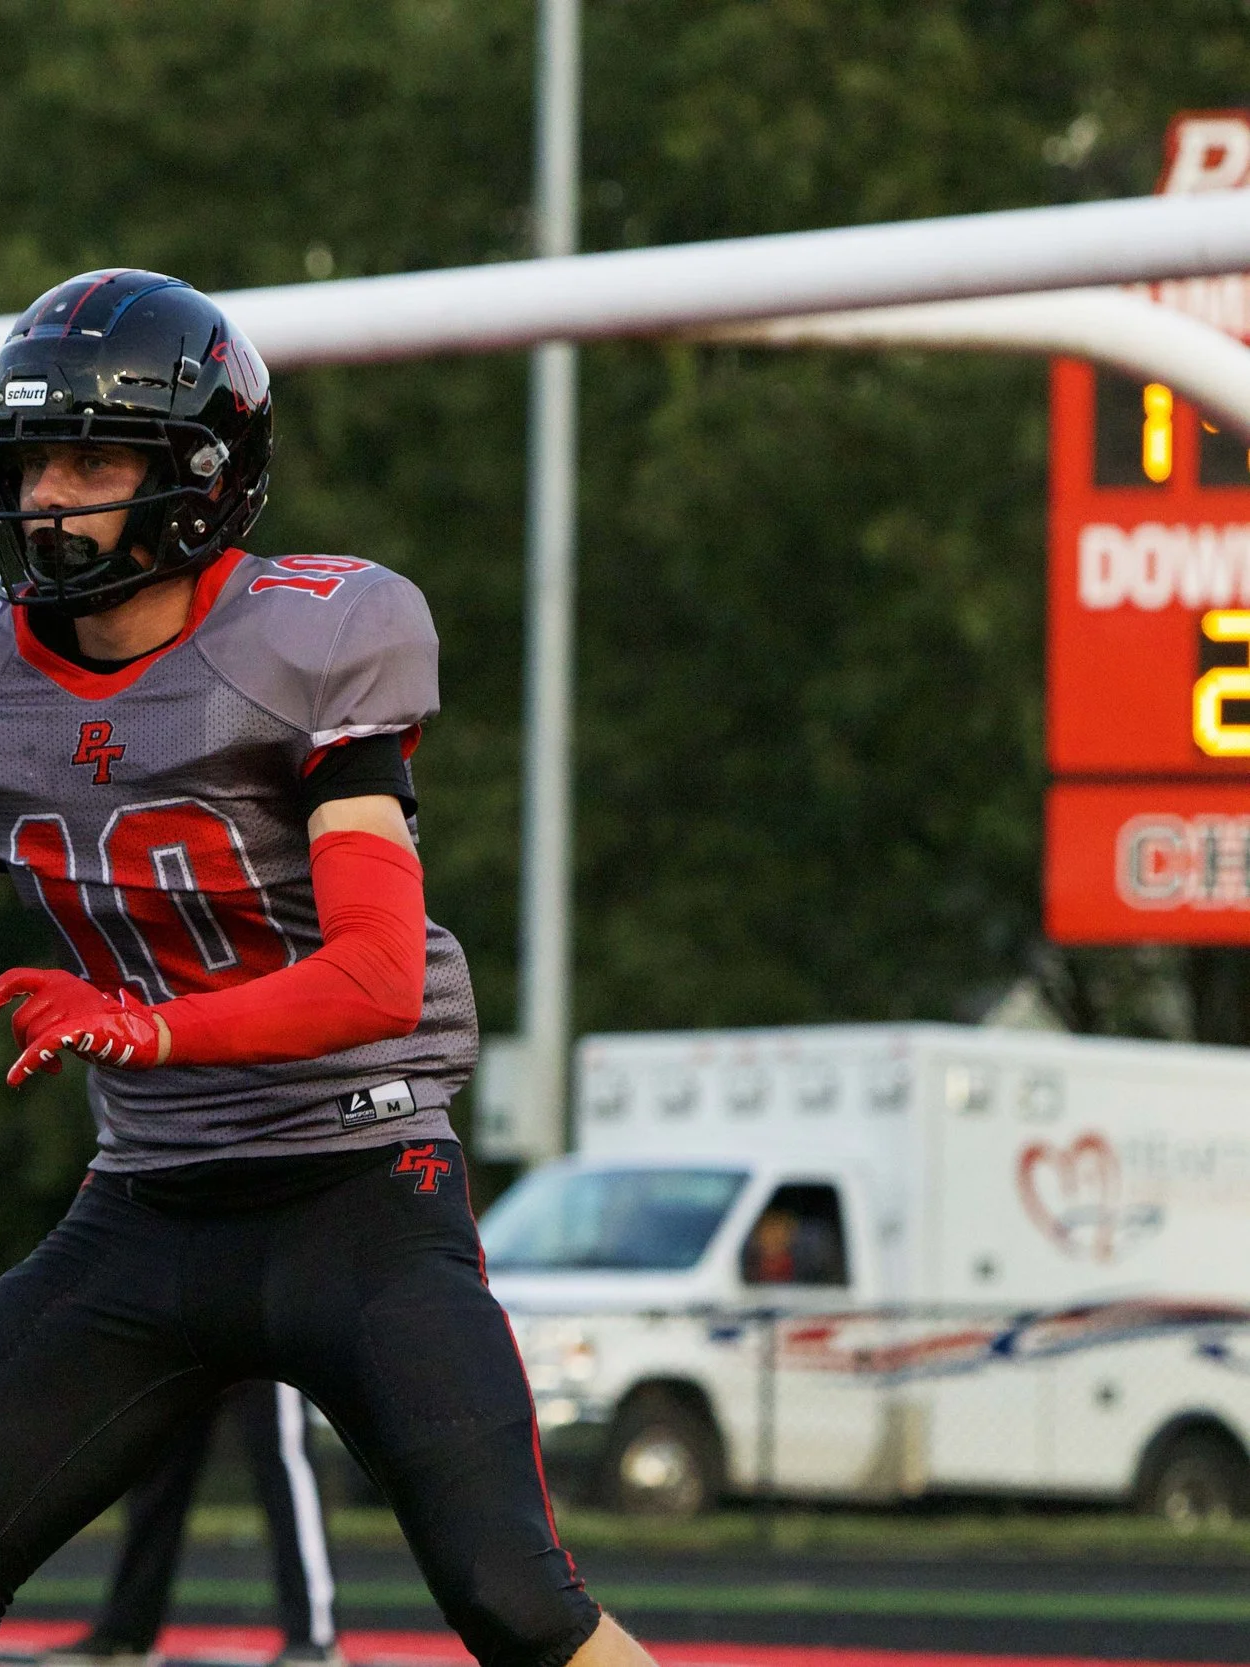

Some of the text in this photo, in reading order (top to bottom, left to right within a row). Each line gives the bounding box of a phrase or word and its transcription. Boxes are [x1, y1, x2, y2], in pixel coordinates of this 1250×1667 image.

[7, 386, 46, 400] schutt
[249, 554, 376, 600] 10
[70, 718, 128, 786] PT
[10, 796, 297, 1006] 10
[386, 1100, 401, 1113] M
